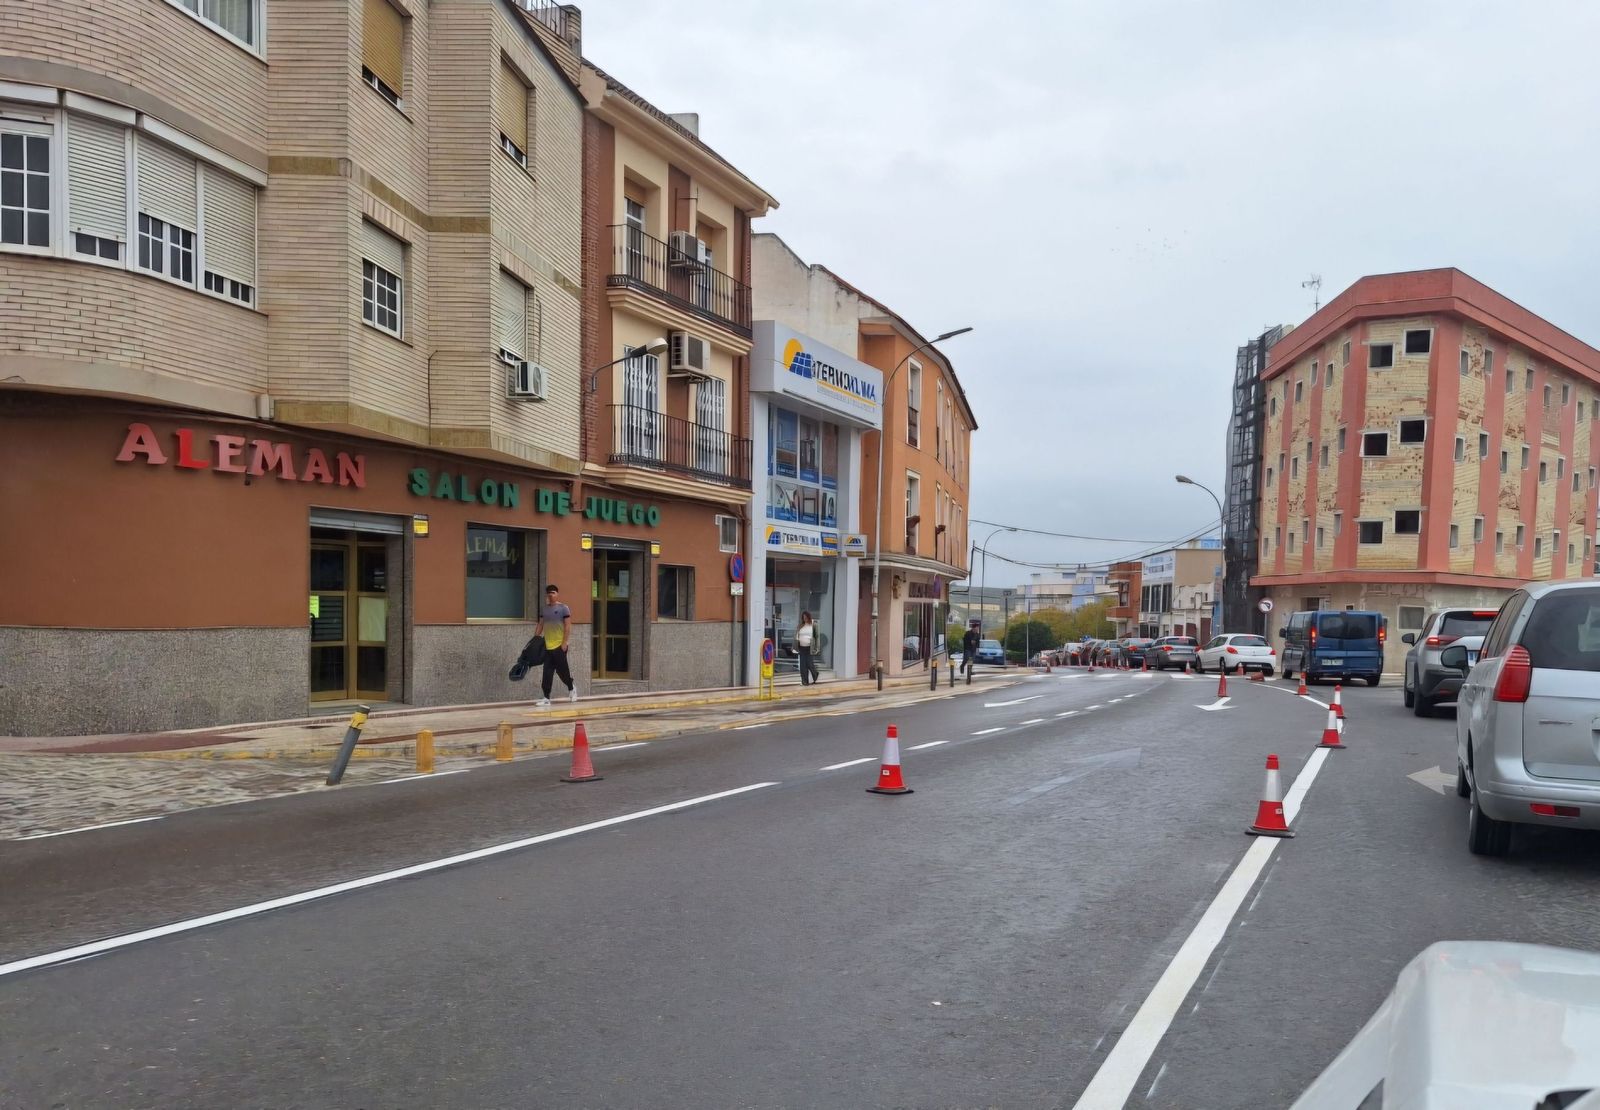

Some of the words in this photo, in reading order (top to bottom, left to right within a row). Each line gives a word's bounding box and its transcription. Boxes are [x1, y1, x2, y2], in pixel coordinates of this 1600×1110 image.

[115, 422, 366, 488] ALEMAN
[408, 467, 519, 508] SALON
[535, 487, 572, 517] DE
[582, 495, 661, 527] JUEGO
